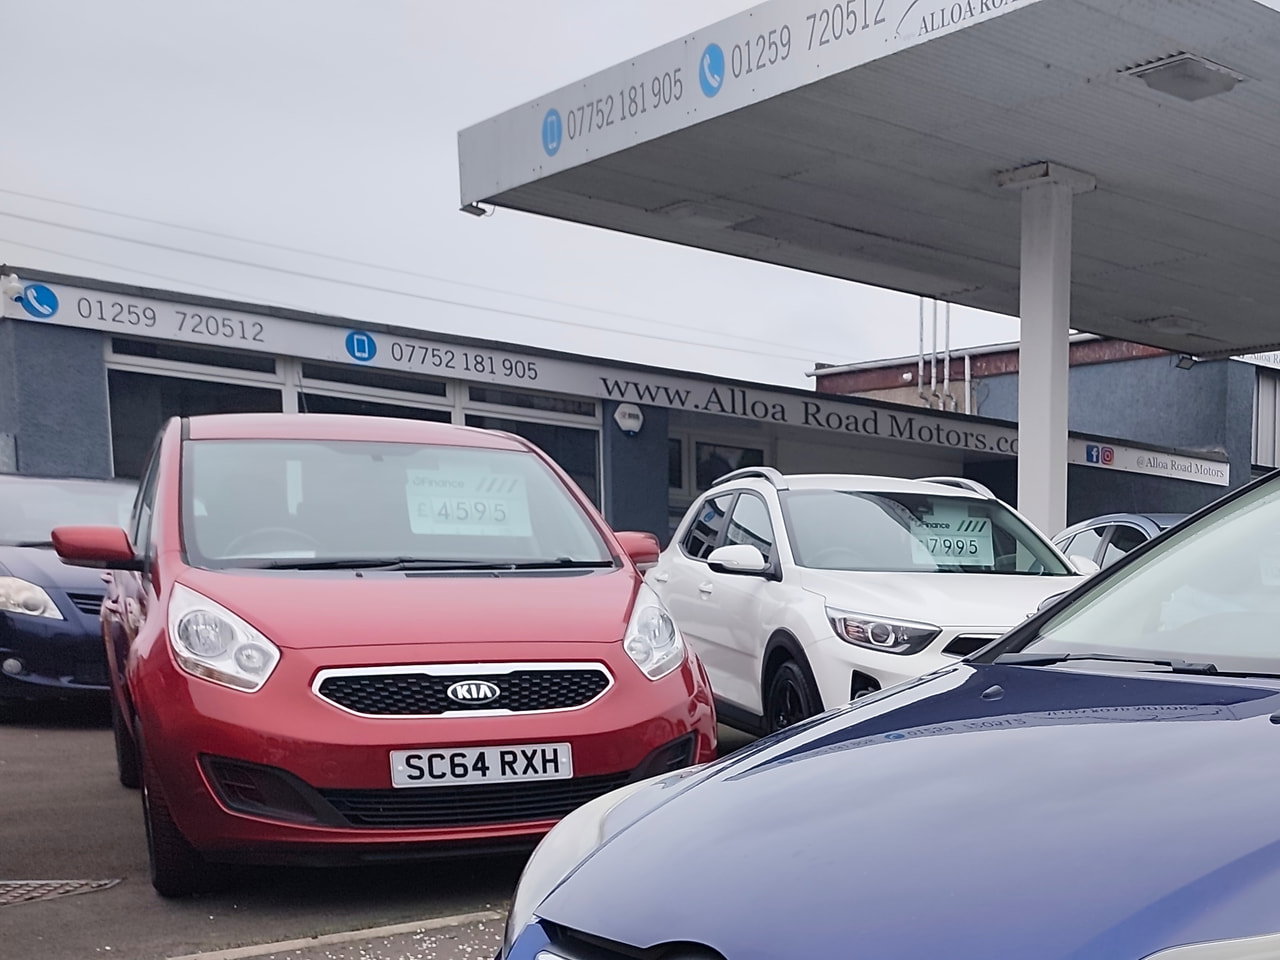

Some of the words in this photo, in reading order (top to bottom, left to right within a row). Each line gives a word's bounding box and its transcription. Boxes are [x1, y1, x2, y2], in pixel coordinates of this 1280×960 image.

[918, 2, 975, 36] ALLOA
[731, 24, 791, 79] 01259
[806, 0, 886, 50] 720512
[567, 95, 614, 140] 07752
[619, 82, 647, 121] 181
[651, 68, 683, 108] 905
[77, 297, 156, 328] 01259
[175, 311, 265, 343] 720512
[391, 342, 455, 369] 07752
[463, 352, 496, 375] 181
[503, 359, 538, 381] 905
[600, 377, 787, 423] www.Alloa
[801, 401, 879, 436] Road
[1171, 462, 1193, 474] Road
[1194, 463, 1225, 479] Motors
[456, 684, 494, 699] KIA
[404, 751, 490, 781] SC64
[500, 748, 560, 777] RXH
